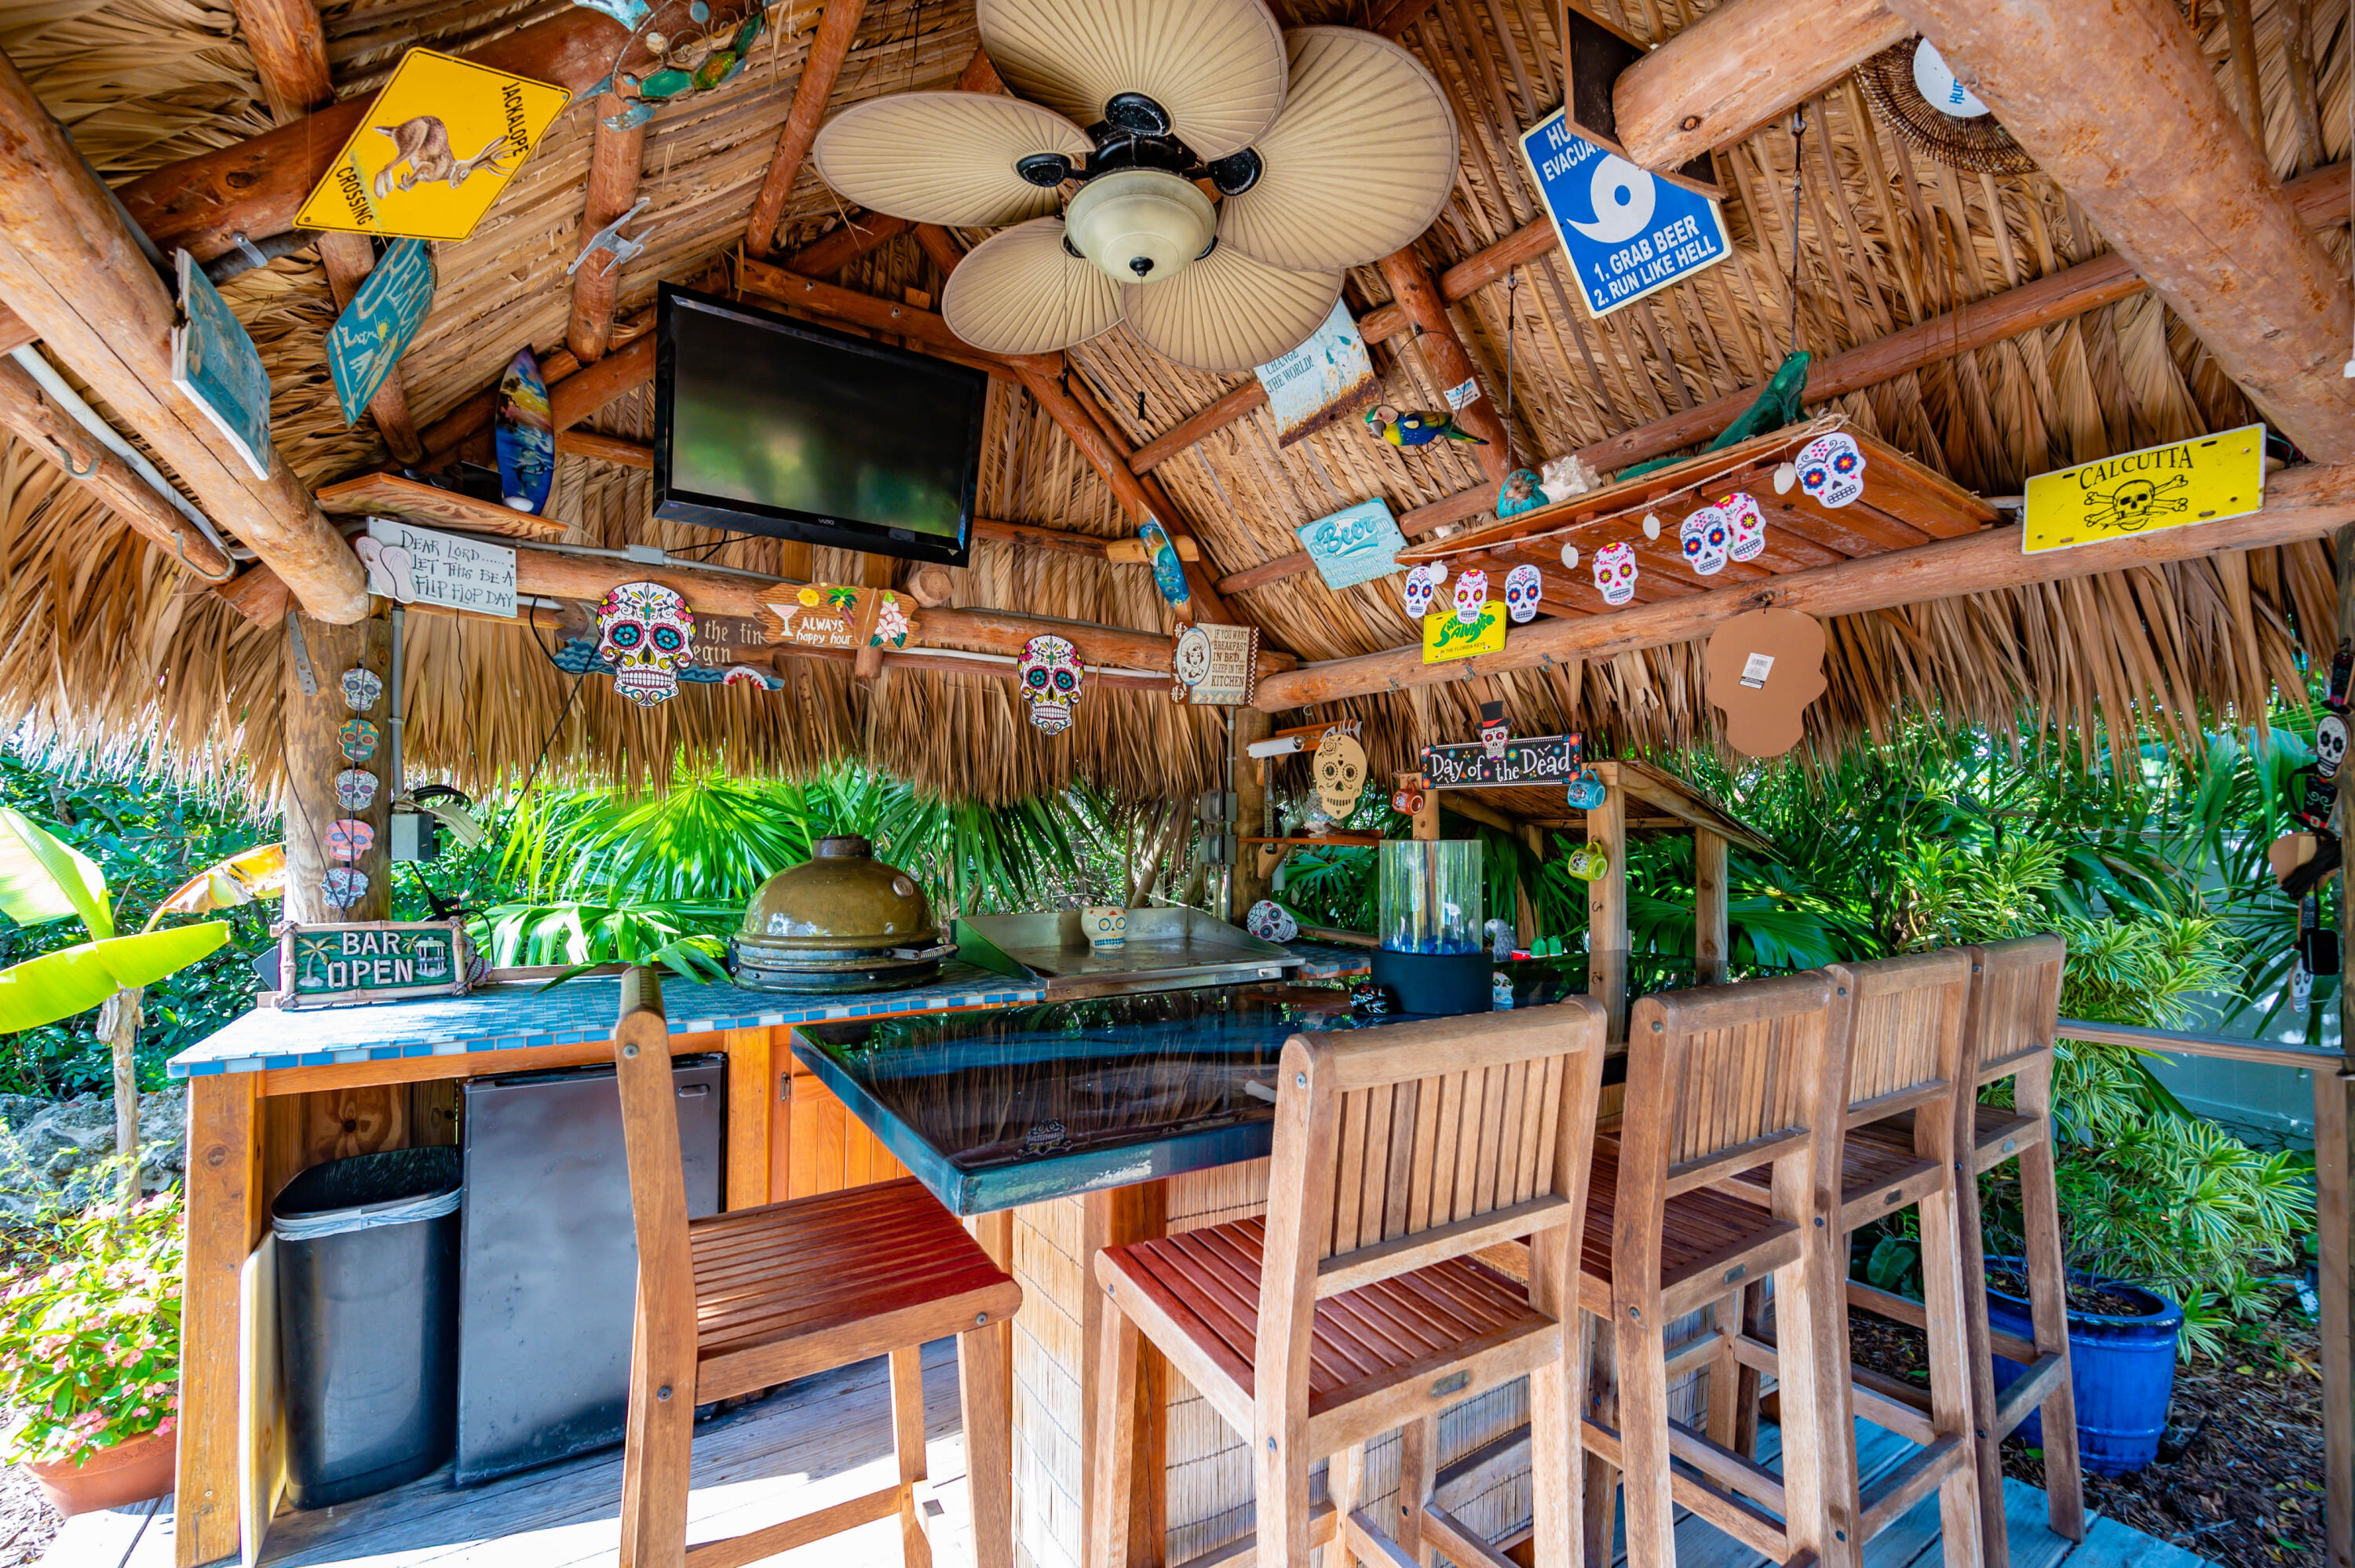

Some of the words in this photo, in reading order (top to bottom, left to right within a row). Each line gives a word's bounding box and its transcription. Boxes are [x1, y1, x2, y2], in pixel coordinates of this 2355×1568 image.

[502, 82, 529, 158] JACKALOPE
[1546, 119, 1572, 151] HU
[1542, 140, 1600, 181] EVACUA
[336, 166, 374, 226] CROSSING
[1594, 262, 1610, 283] 1.
[1609, 239, 1653, 275] GRAB
[1652, 215, 1700, 253] BEER
[1594, 289, 1608, 307] 2.
[1608, 272, 1640, 300] RUN
[1639, 253, 1675, 285] LIKE
[1674, 235, 1717, 268] HELL
[1265, 374, 1285, 392] THE
[1282, 354, 1314, 382] WORLD!
[2079, 444, 2193, 490] CALCUTTA
[401, 530, 440, 556] DEAR
[1316, 516, 1376, 553] Beer
[412, 554, 439, 574] LET
[443, 563, 473, 580] THIS
[415, 575, 447, 599] FLIP
[452, 583, 483, 604] FLOP
[486, 590, 514, 607] DAY
[705, 620, 728, 644] the
[796, 629, 825, 645] happy
[830, 632, 853, 645] hour
[801, 617, 844, 633] ALWAYS
[1214, 629, 1220, 639] IF
[1221, 629, 1232, 640] YOU
[1232, 630, 1247, 640] WANT
[693, 645, 731, 665] egin
[1213, 652, 1222, 662] IN
[1214, 640, 1247, 651] BREAKFAST
[1211, 675, 1245, 687] KITCHEN
[1212, 663, 1227, 673] SLEEP
[1228, 664, 1235, 673] IN
[1236, 665, 1245, 674] THE
[1430, 753, 1463, 782] Day
[1468, 755, 1485, 780] of
[1495, 760, 1520, 782] the
[1520, 742, 1571, 775] Dead
[342, 932, 401, 956] BAR
[327, 959, 414, 989] OPEN
